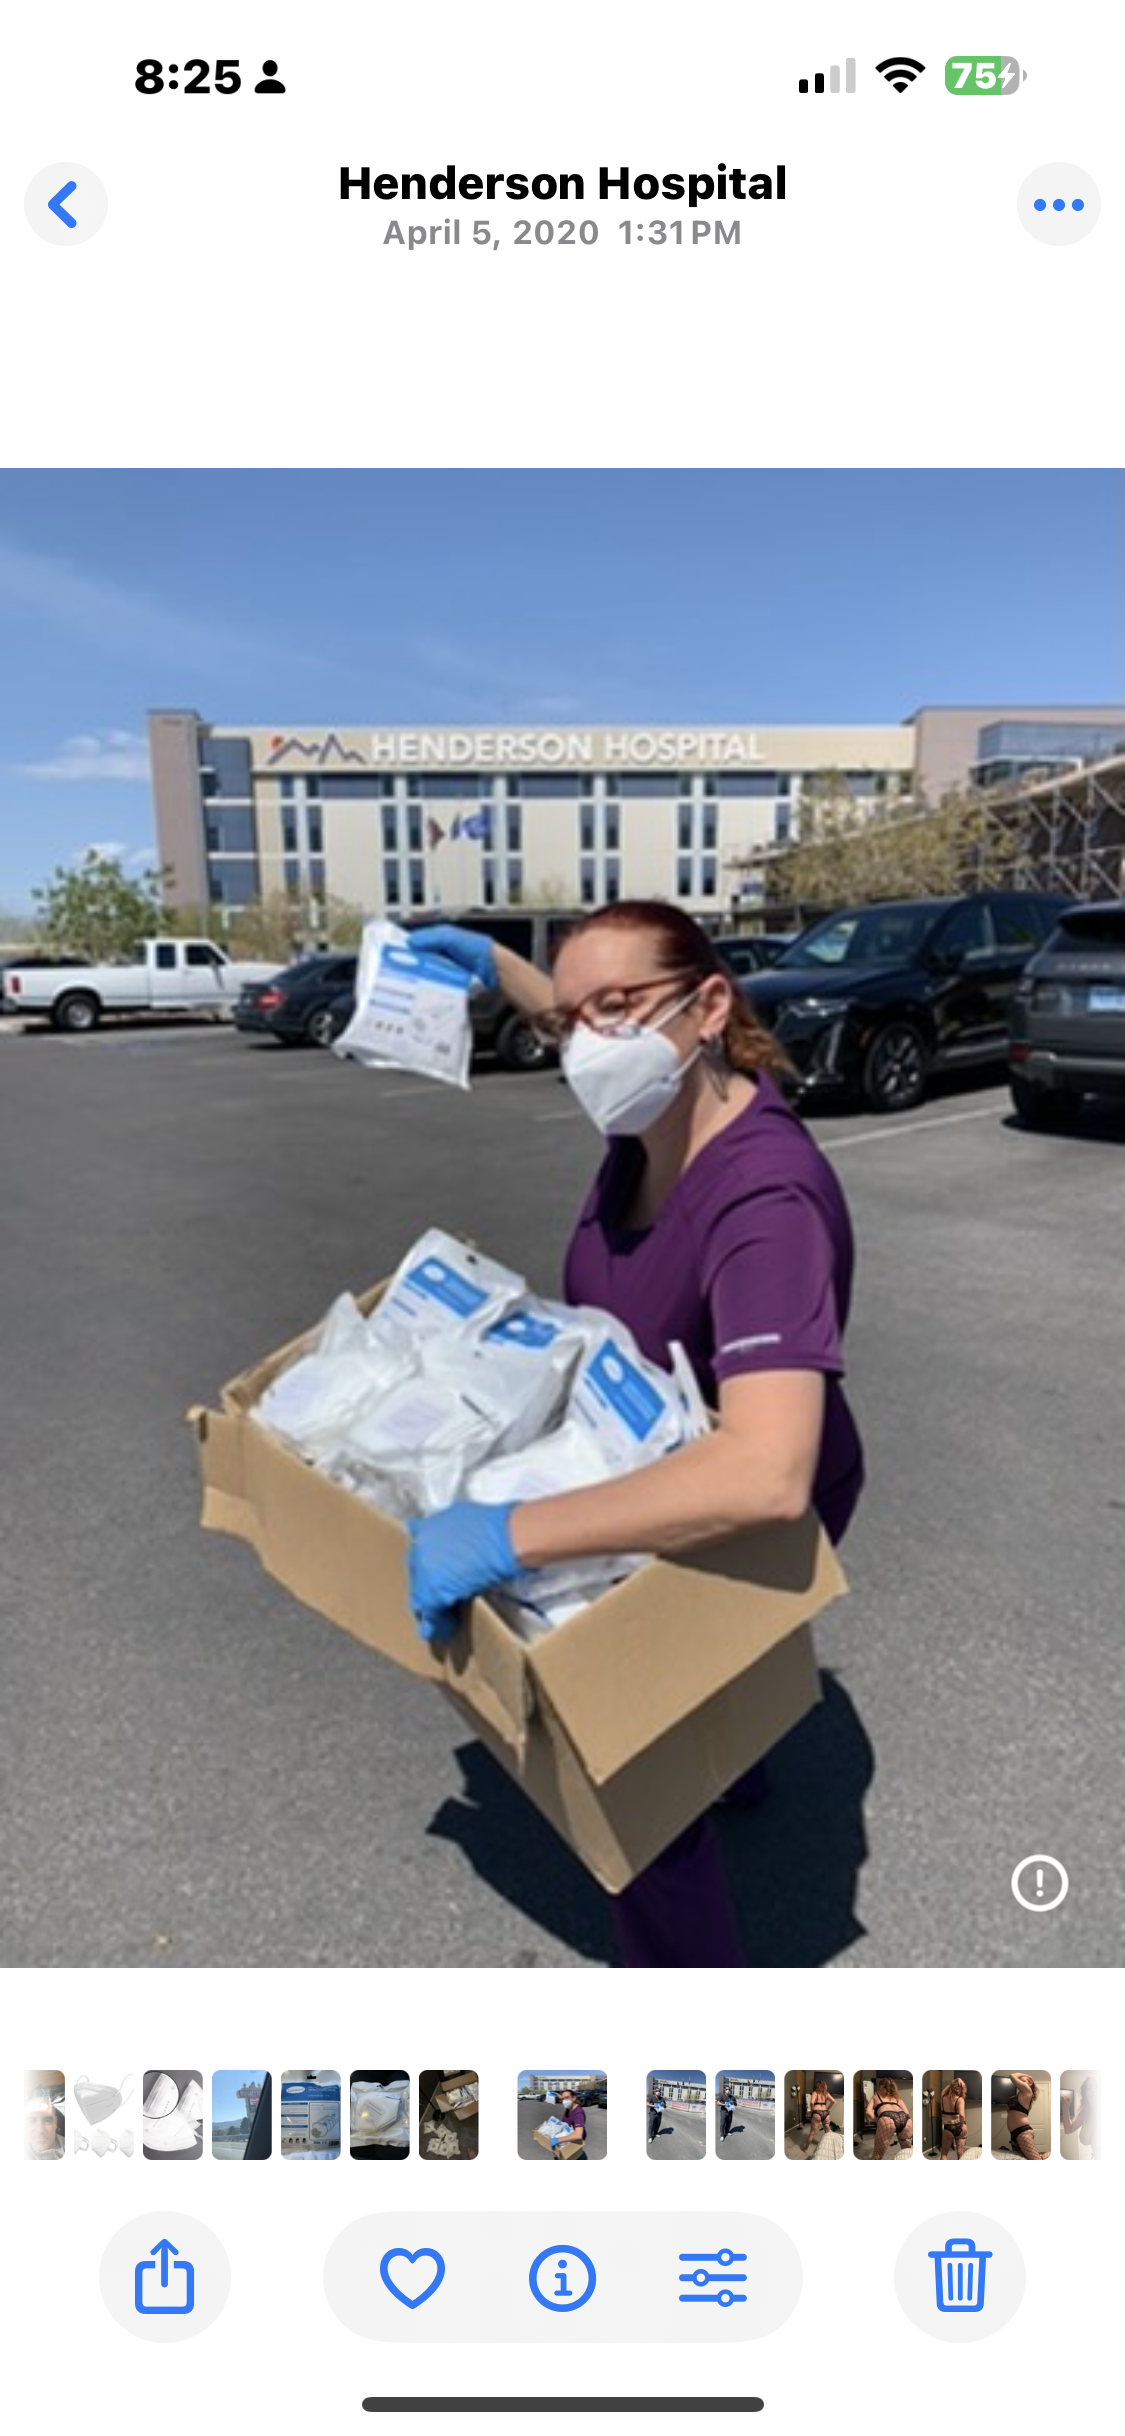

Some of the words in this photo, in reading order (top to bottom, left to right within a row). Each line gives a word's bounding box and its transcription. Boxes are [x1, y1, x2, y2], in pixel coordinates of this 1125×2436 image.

[134, 58, 242, 95] 8:25
[951, 62, 997, 90] 75
[340, 164, 584, 201] Henderson
[599, 162, 786, 208] Hospital
[382, 217, 460, 251] April
[472, 220, 500, 251] 5,
[513, 219, 599, 246] 2020
[371, 732, 593, 763] HENDERSON
[604, 732, 765, 763] HOSPITAL
